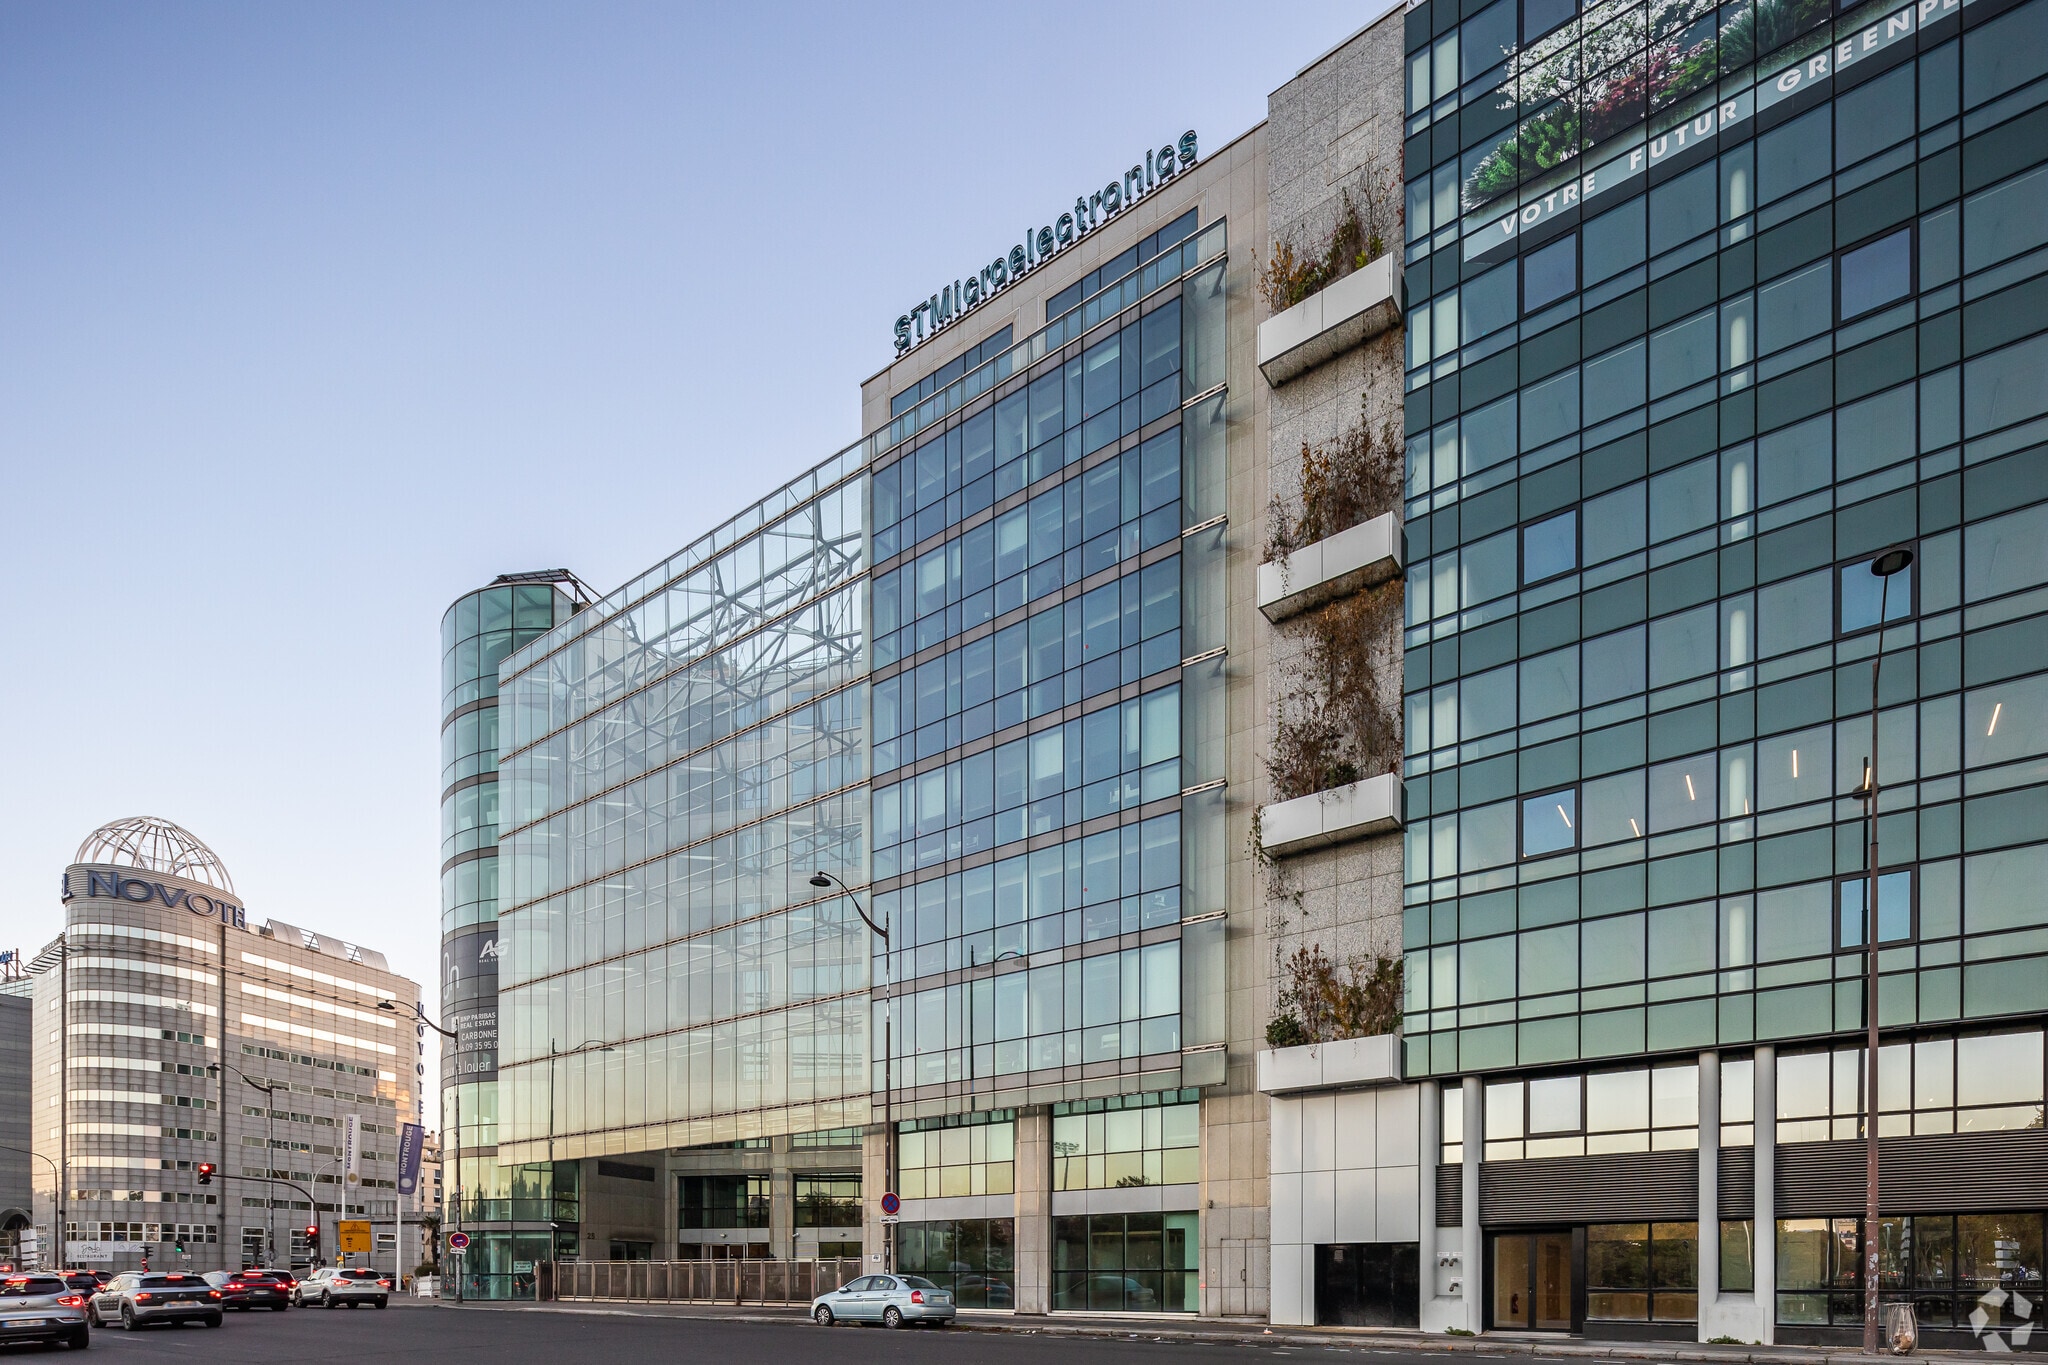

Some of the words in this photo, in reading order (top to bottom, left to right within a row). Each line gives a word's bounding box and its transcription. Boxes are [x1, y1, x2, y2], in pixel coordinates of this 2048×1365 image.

[1500, 173, 1596, 235] VOTRE
[1629, 100, 1737, 171] FUTUR
[893, 129, 1199, 351] STMicroelectronics
[471, 1012, 496, 1020] PARIBAS
[461, 1030, 498, 1041] CARBONNE
[474, 1042, 483, 1050] 35
[484, 1041, 492, 1049] 95
[464, 1061, 491, 1074] louer
[400, 1125, 414, 1175] MONTROUGE
